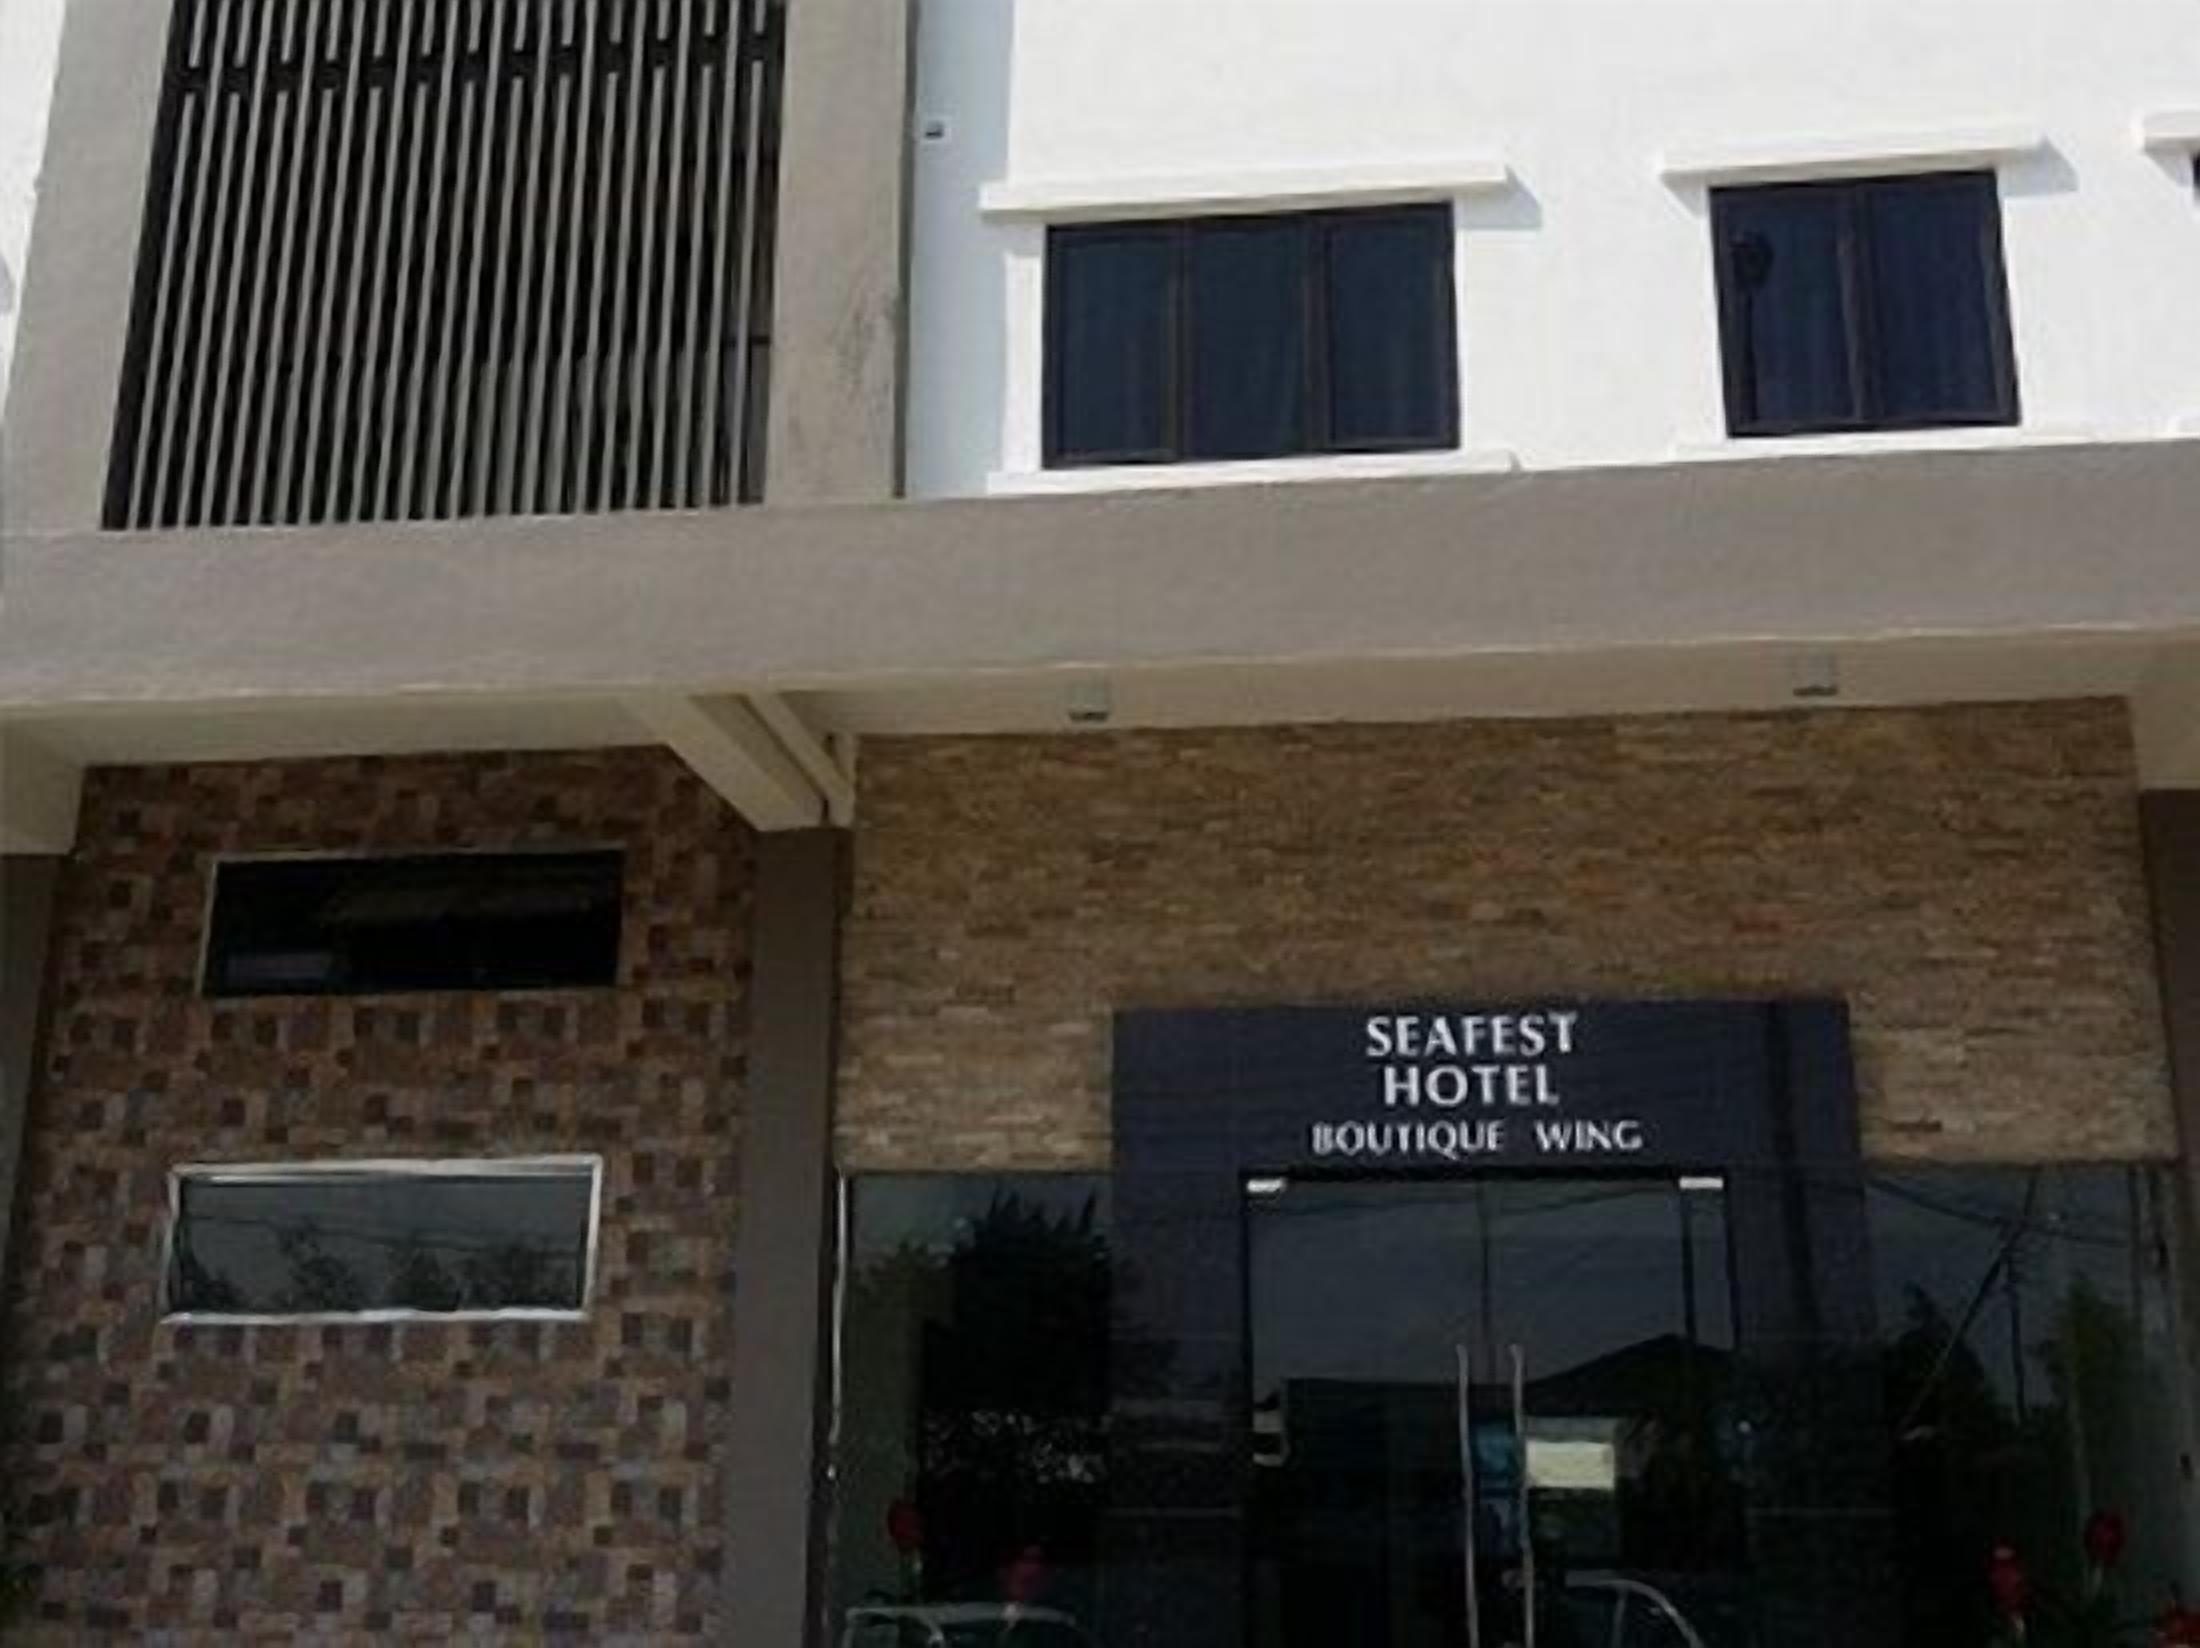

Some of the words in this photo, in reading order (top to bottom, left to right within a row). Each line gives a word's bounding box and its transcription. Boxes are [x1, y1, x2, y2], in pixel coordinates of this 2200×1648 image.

[1366, 1012, 1577, 1056] SEAFEST
[1383, 1064, 1560, 1106] HOTEL
[1311, 1119, 1505, 1160] BOUTIQUE
[1534, 1118, 1643, 1152] WING
